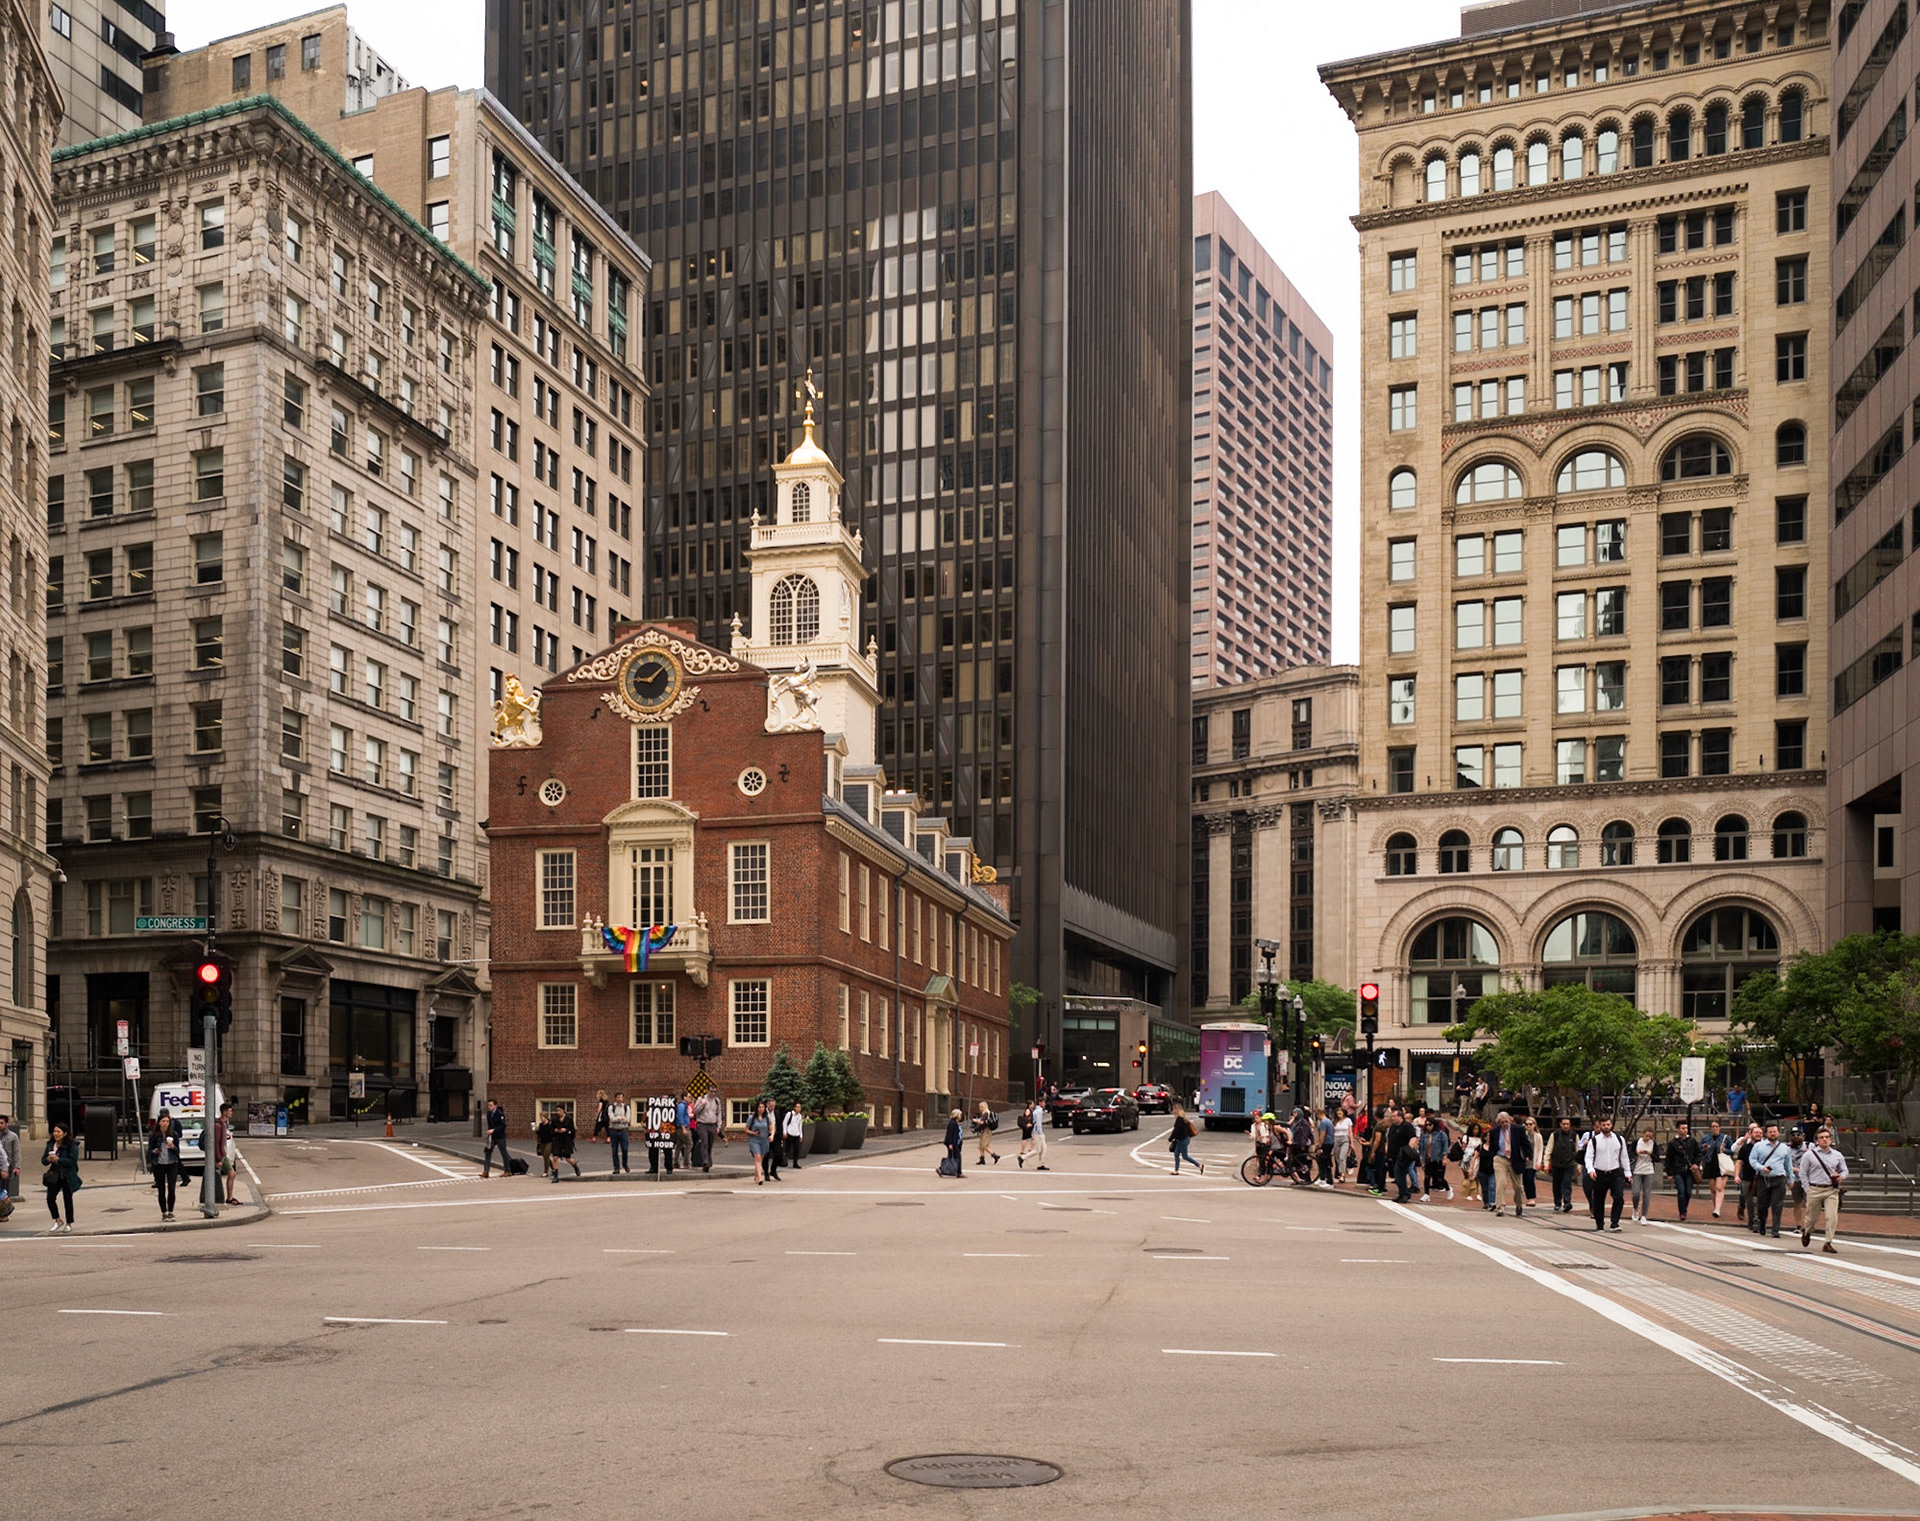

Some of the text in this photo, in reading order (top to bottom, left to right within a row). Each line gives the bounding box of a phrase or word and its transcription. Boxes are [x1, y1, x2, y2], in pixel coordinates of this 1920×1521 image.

[148, 918, 195, 928] CONGRESS
[194, 1054, 202, 1062] NO
[192, 1063, 206, 1071] TURN
[1224, 1058, 1242, 1069] DC
[190, 1072, 197, 1080] ON
[1325, 1081, 1351, 1090] NOW
[1325, 1090, 1346, 1099] OPE
[649, 1097, 675, 1107] PARK
[661, 1132, 671, 1140] TO
